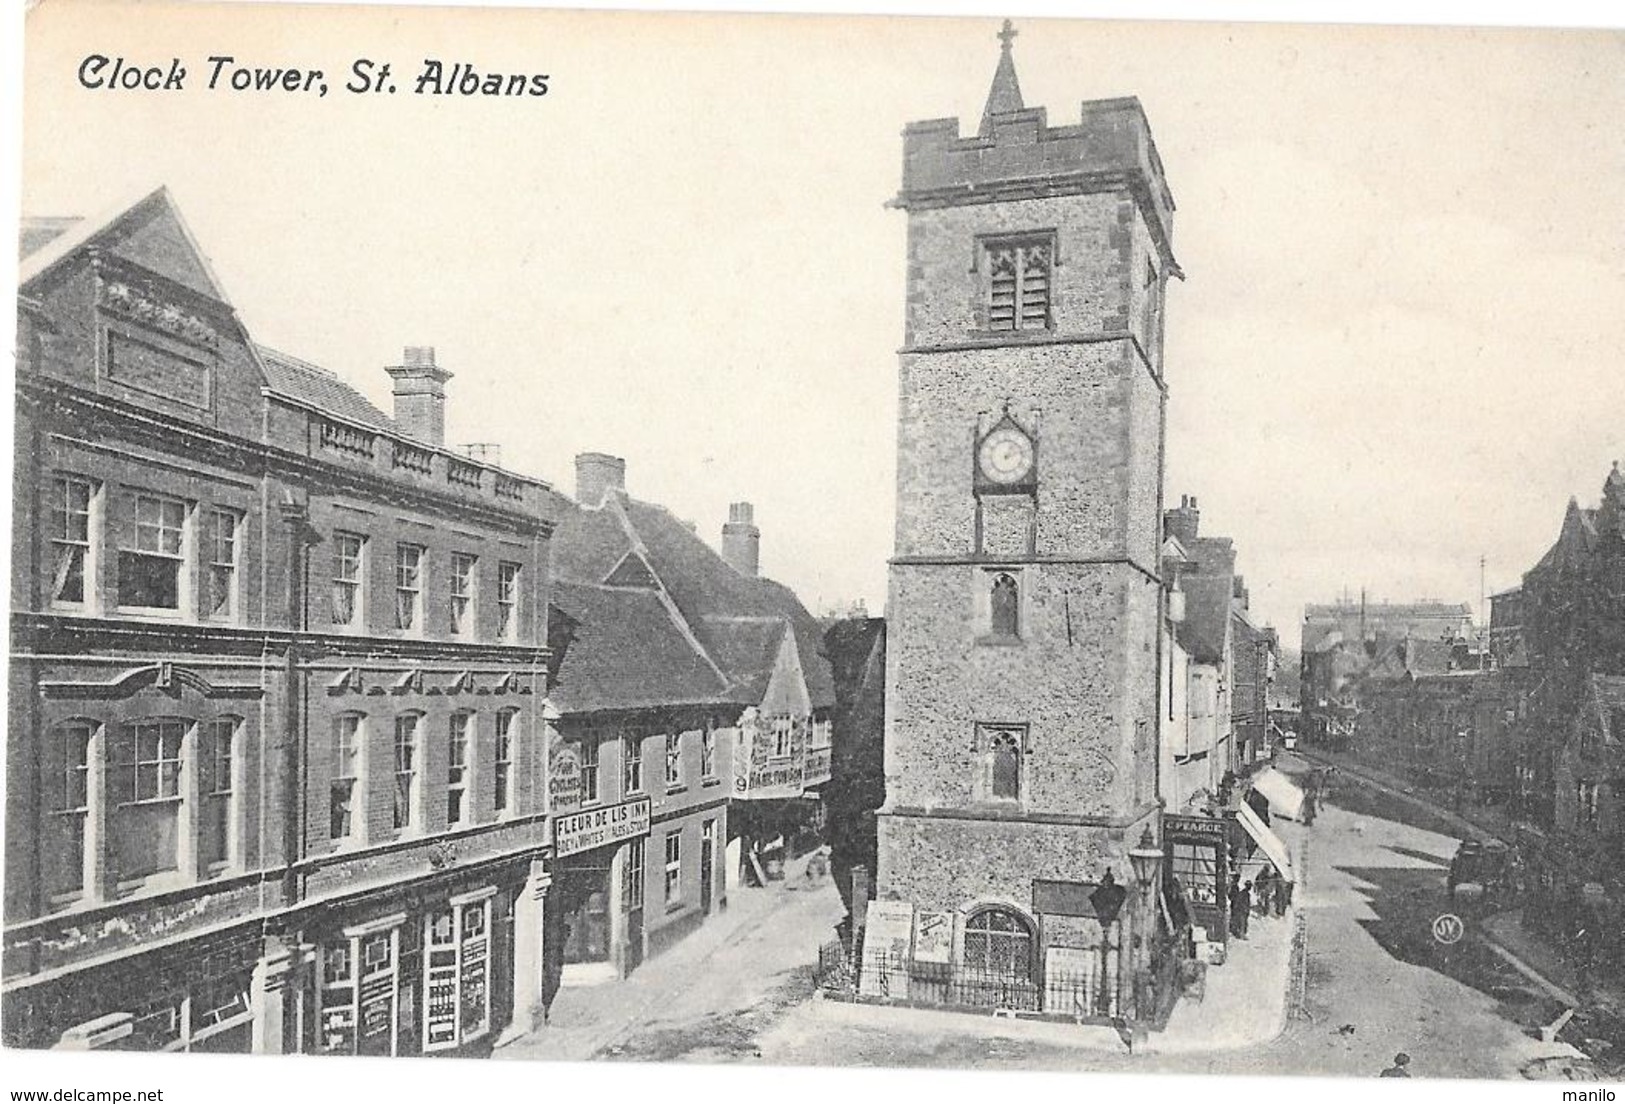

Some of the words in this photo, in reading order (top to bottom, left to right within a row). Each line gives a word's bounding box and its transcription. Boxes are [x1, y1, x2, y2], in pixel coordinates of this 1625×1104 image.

[558, 814, 592, 836] FLEUR
[595, 811, 607, 827] DE
[611, 806, 627, 823] LIS
[631, 802, 648, 818] INN
